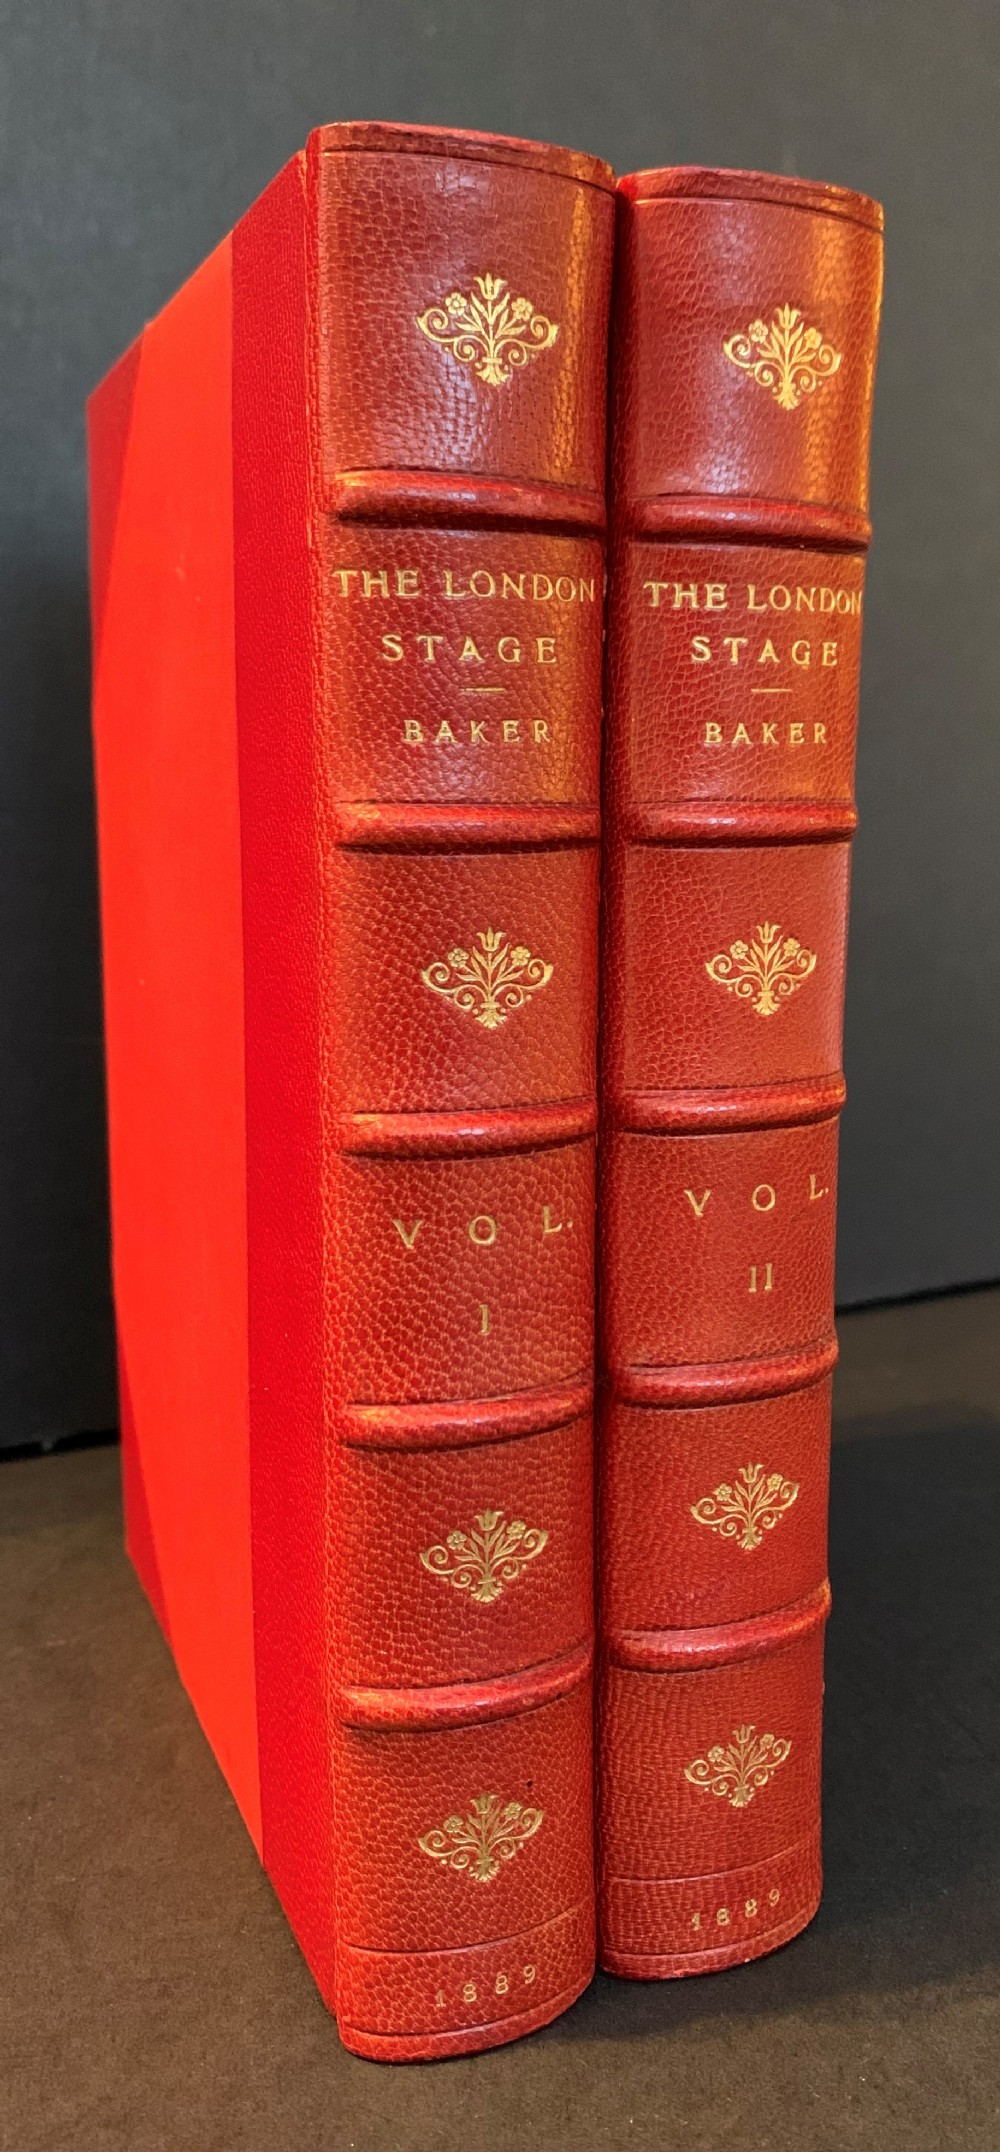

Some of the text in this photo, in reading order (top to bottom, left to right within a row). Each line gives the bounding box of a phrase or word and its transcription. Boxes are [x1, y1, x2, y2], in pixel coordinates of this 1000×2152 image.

[333, 569, 595, 602] THE LONDON
[643, 581, 862, 616] THE LONDON
[381, 634, 557, 664] STAGE
[691, 636, 838, 666] STAGE
[403, 719, 551, 744] BAKER
[704, 722, 827, 745] BAKER
[748, 1262, 773, 1292] II
[478, 1303, 491, 1337] I
[691, 1888, 780, 1931] 1889
[435, 1964, 536, 2008] 1889
